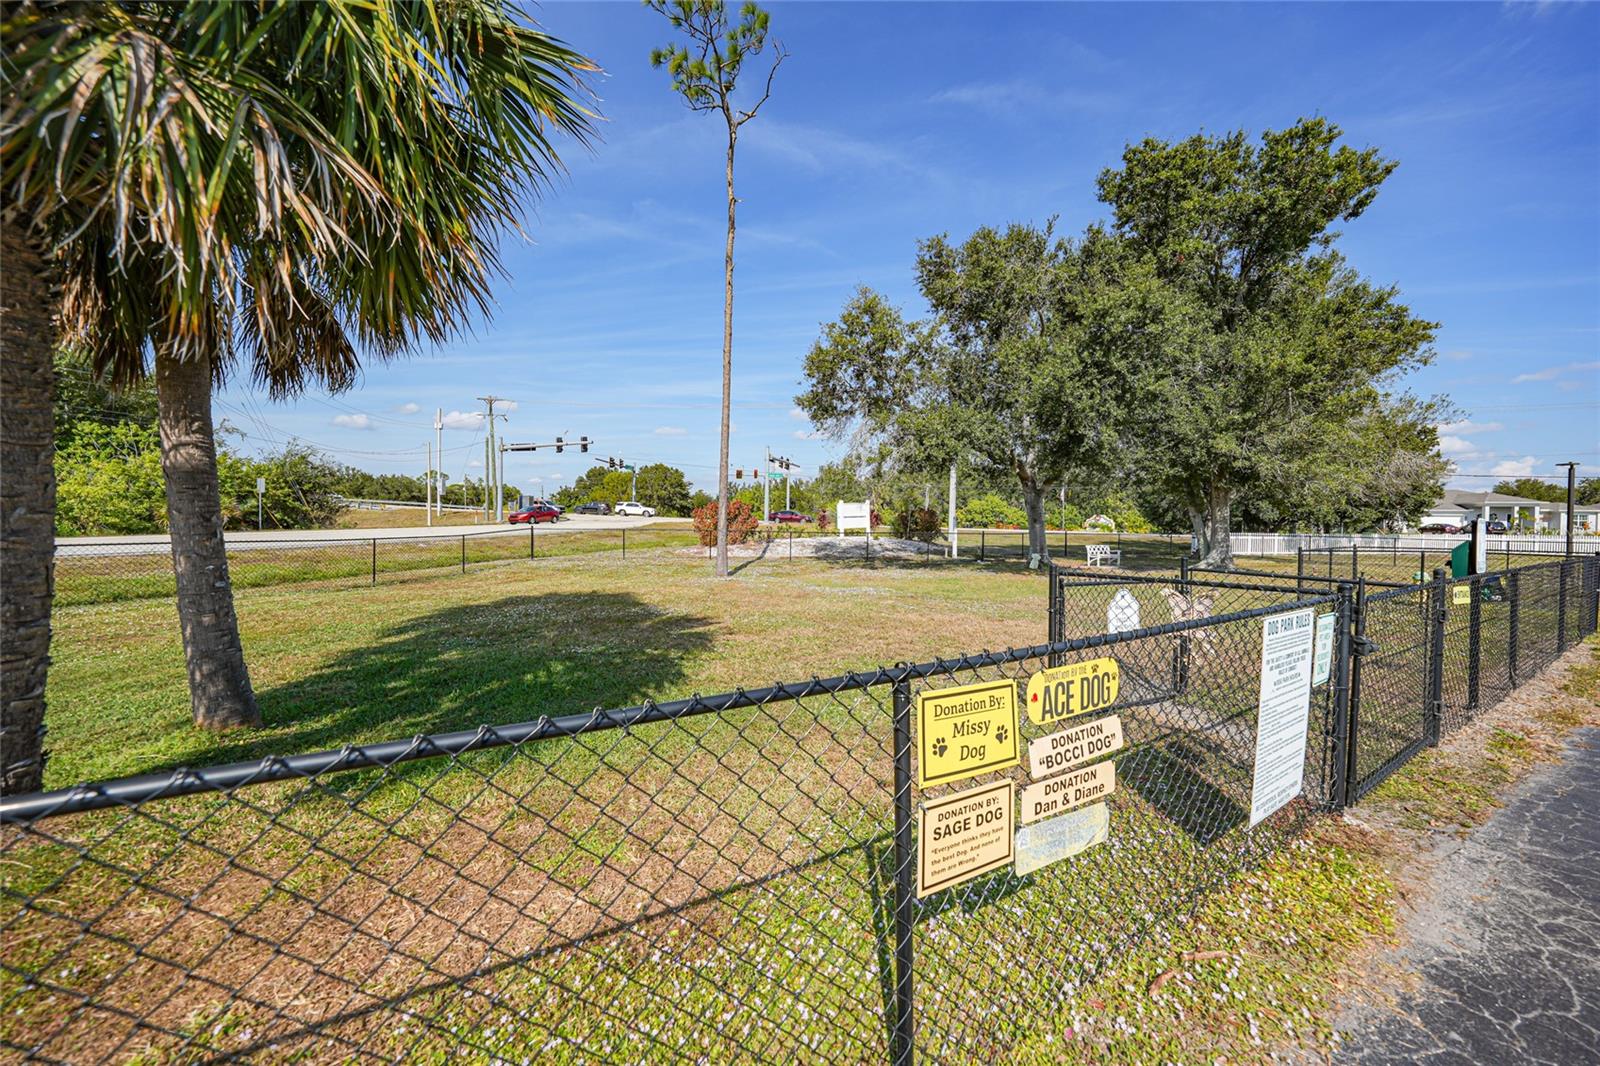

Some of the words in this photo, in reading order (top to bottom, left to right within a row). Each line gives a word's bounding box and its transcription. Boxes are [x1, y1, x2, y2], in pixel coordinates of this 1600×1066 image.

[1268, 620, 1279, 636] DOG
[1280, 617, 1294, 633] PARK
[1296, 613, 1310, 629] RULES
[934, 698, 986, 718] Donation
[989, 695, 1005, 710] By:
[1041, 680, 1075, 721] ACE
[1080, 672, 1111, 711] DOG
[952, 719, 991, 738] Missy
[1051, 724, 1104, 750] DONATION
[960, 744, 986, 762] Dog
[1044, 769, 1098, 796] DONATION
[938, 802, 984, 823] DONATION
[986, 796, 999, 810] BY:
[1034, 799, 1058, 816] Dan
[1062, 792, 1071, 805] &
[1074, 783, 1105, 802] Diane
[933, 819, 972, 841] SAGE
[976, 807, 1004, 827] DOG
[961, 835, 978, 845] thinks
[992, 826, 1004, 834] have
[942, 853, 955, 862] best
[970, 844, 980, 852] And
[981, 839, 994, 847] none
[931, 867, 946, 877] them
